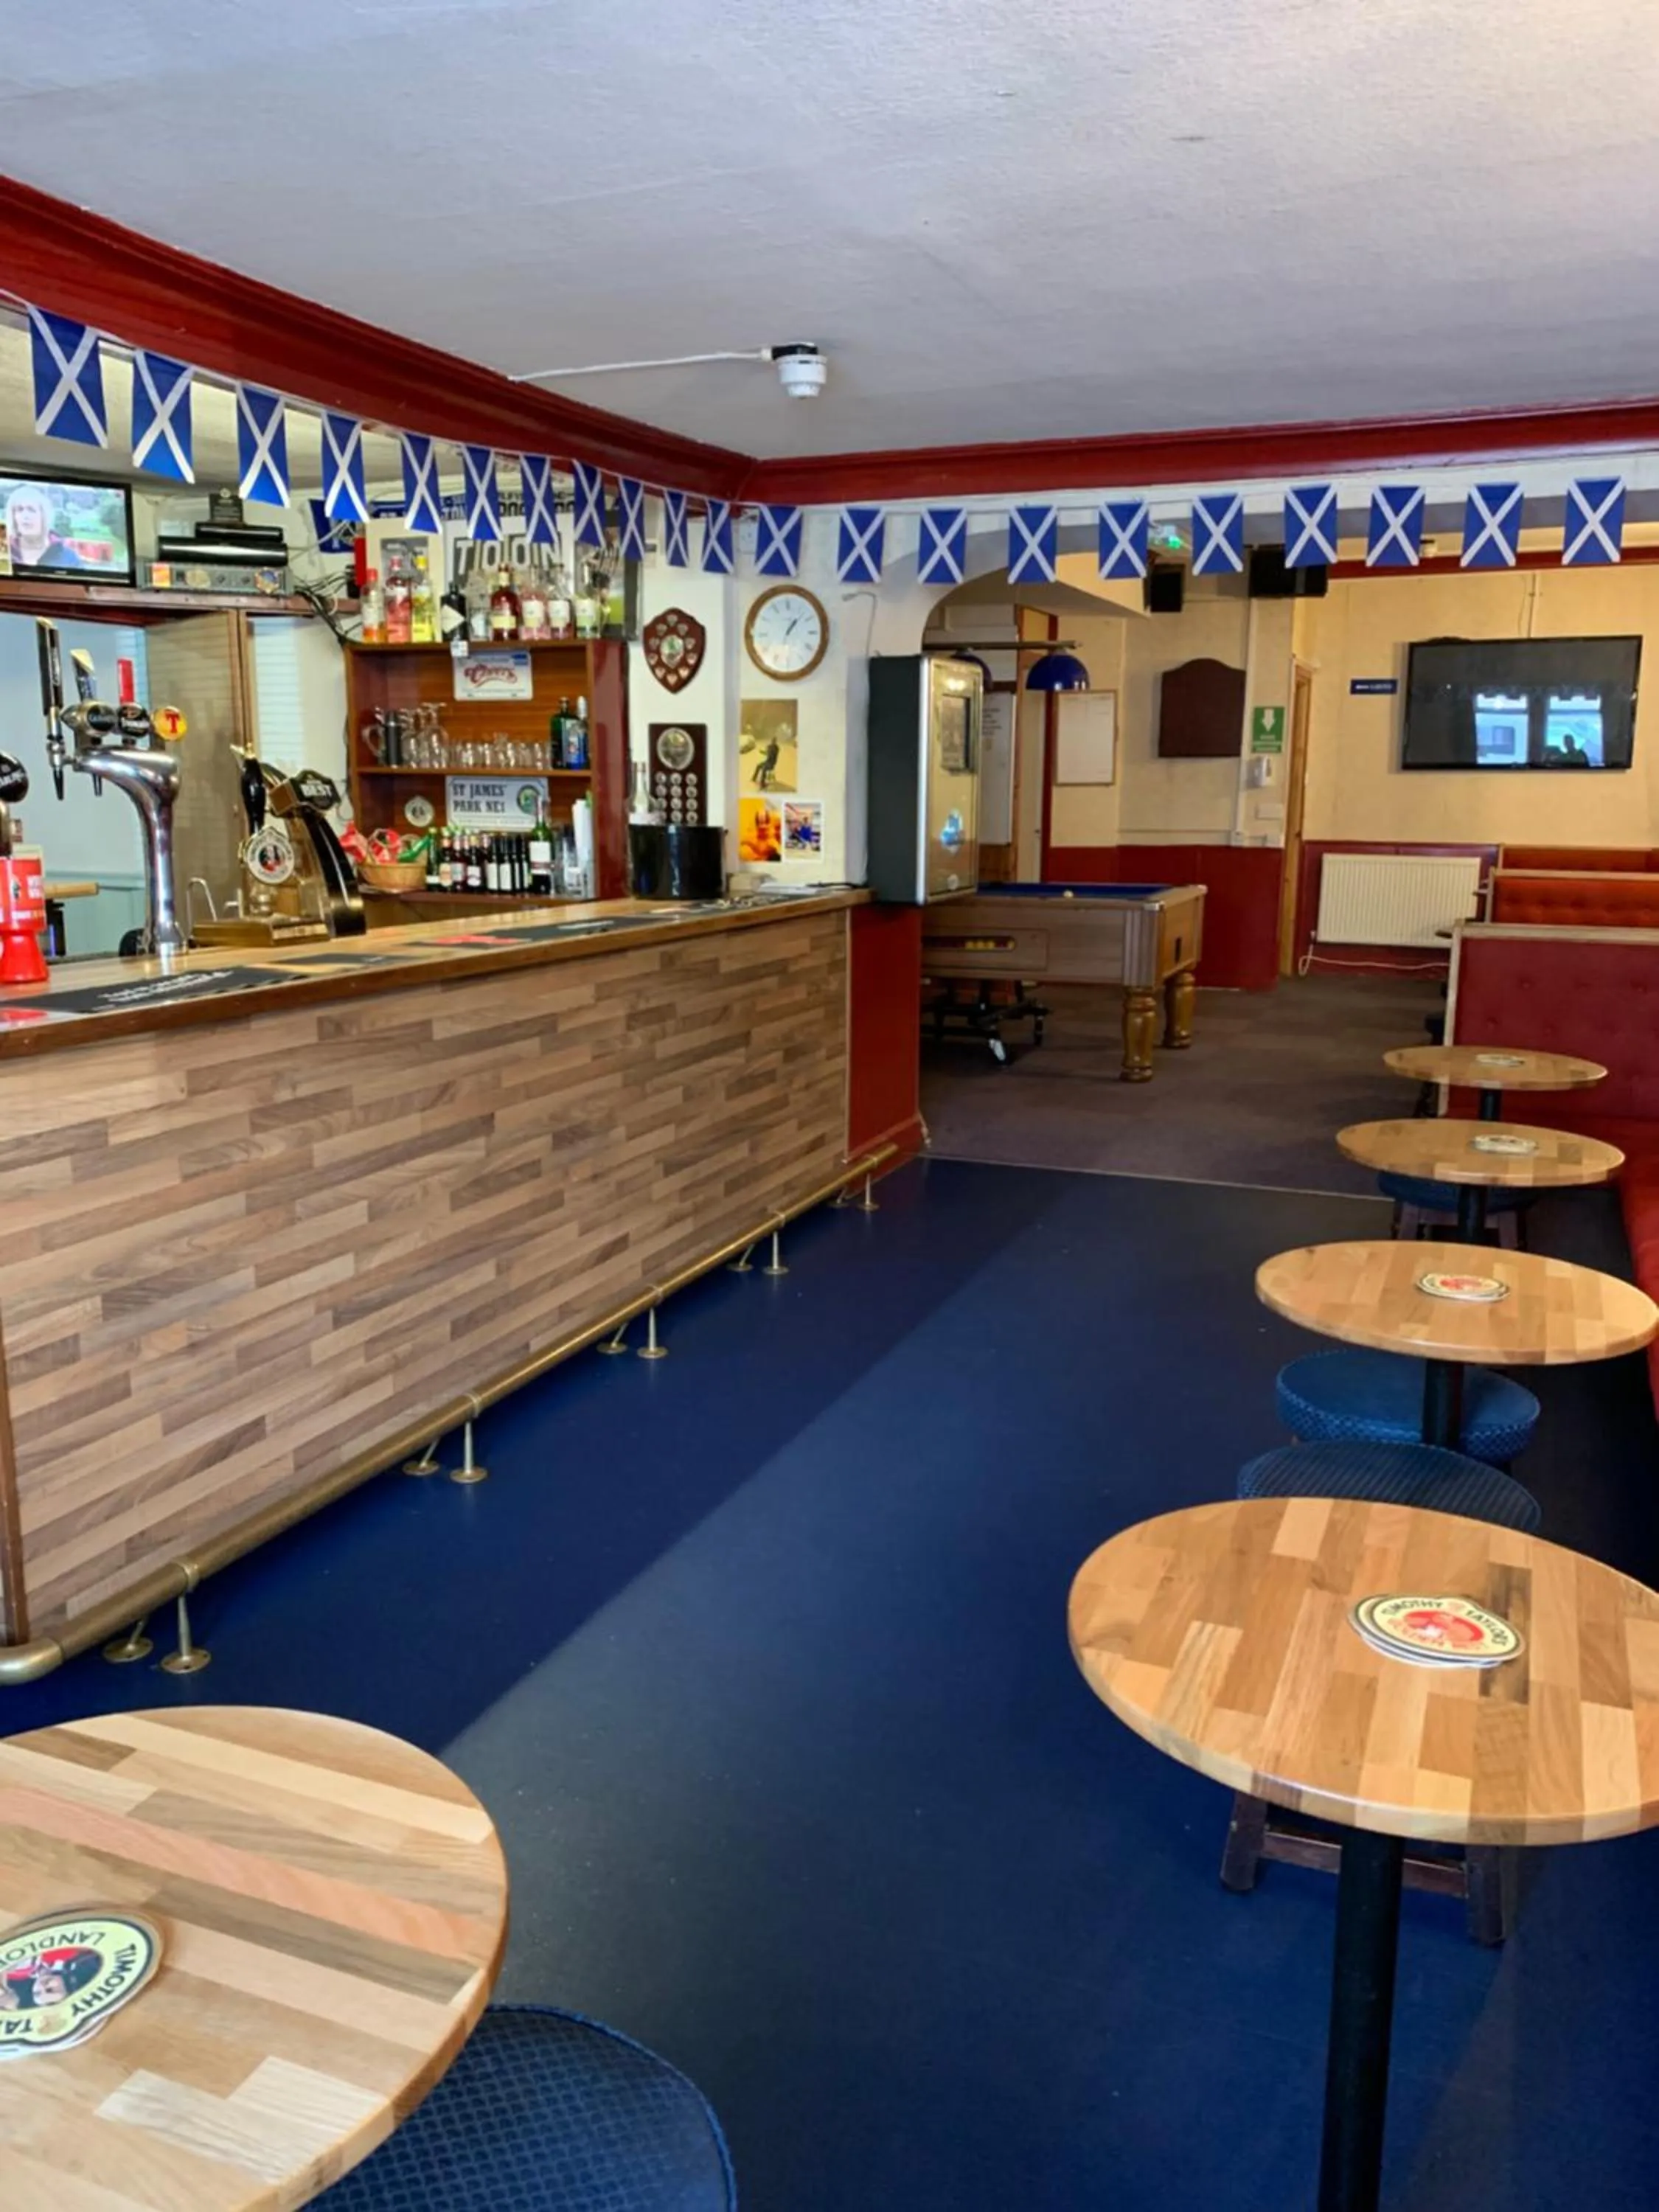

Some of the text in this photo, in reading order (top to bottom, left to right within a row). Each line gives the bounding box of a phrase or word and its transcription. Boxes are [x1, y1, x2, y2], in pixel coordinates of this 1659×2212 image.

[456, 537, 563, 575] TOON
[165, 711, 180, 734] T
[299, 784, 332, 797] BEST
[453, 784, 466, 796] ST
[453, 800, 481, 813] PARK
[0, 1943, 137, 2034] TIMOTHY TA
